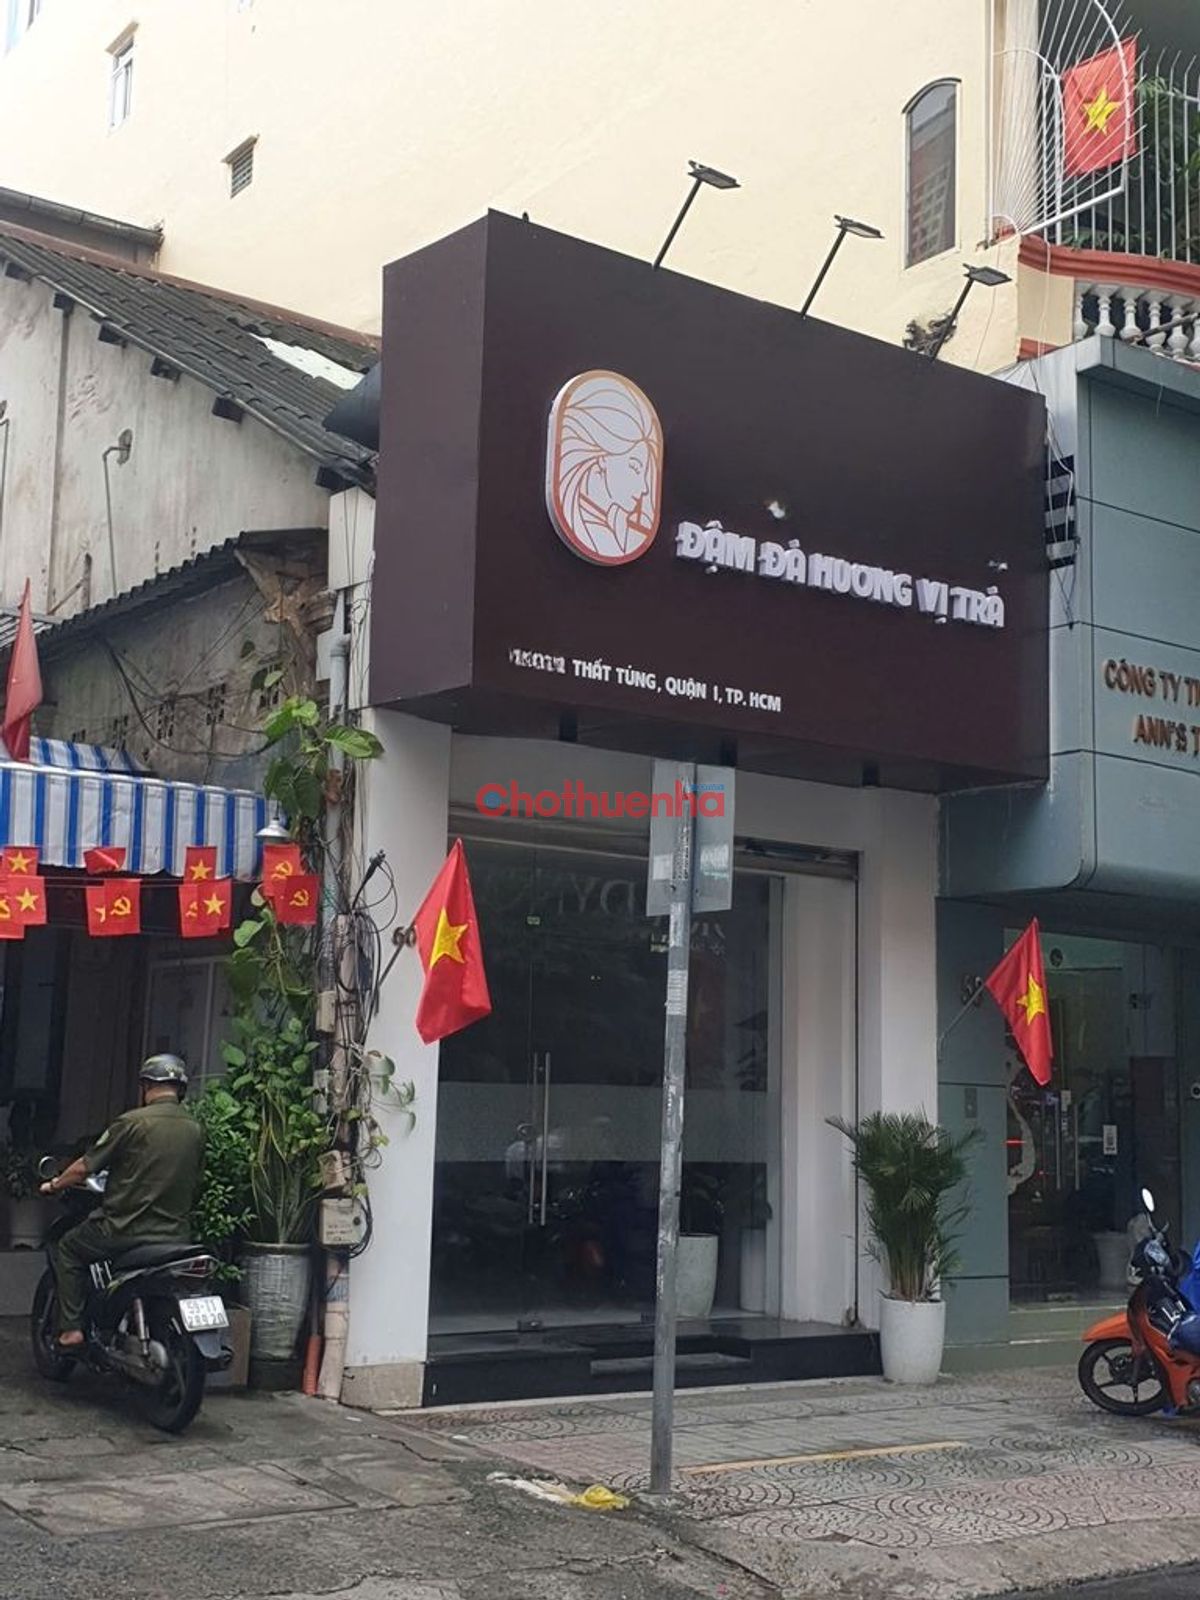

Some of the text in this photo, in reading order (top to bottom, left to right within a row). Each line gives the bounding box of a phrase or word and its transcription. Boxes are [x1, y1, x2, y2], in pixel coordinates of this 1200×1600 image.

[675, 520, 756, 574] ĐẬM
[915, 578, 949, 624] VỊ
[665, 676, 707, 700] QUẬN
[749, 691, 782, 712] HCM
[1104, 658, 1156, 697] CÔNG
[1159, 671, 1182, 702] TY
